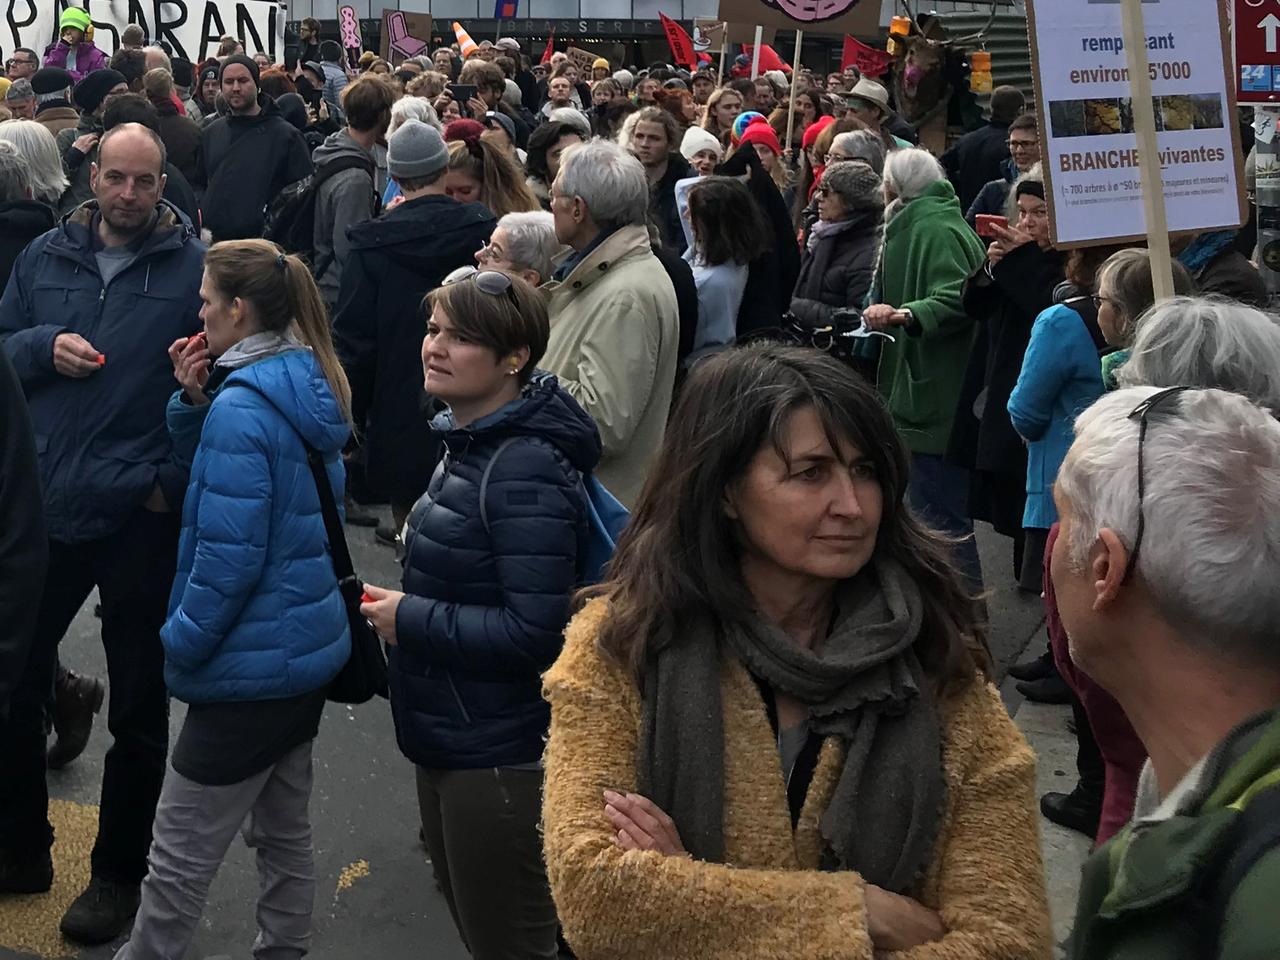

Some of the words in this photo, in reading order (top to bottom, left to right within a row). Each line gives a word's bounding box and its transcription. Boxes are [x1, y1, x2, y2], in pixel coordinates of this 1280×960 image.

[1081, 32, 1176, 55] rempant
[1070, 65, 1130, 84] environ
[1241, 64, 1265, 79] 24
[1158, 145, 1225, 166] vivantes
[1084, 181, 1107, 193] arbres
